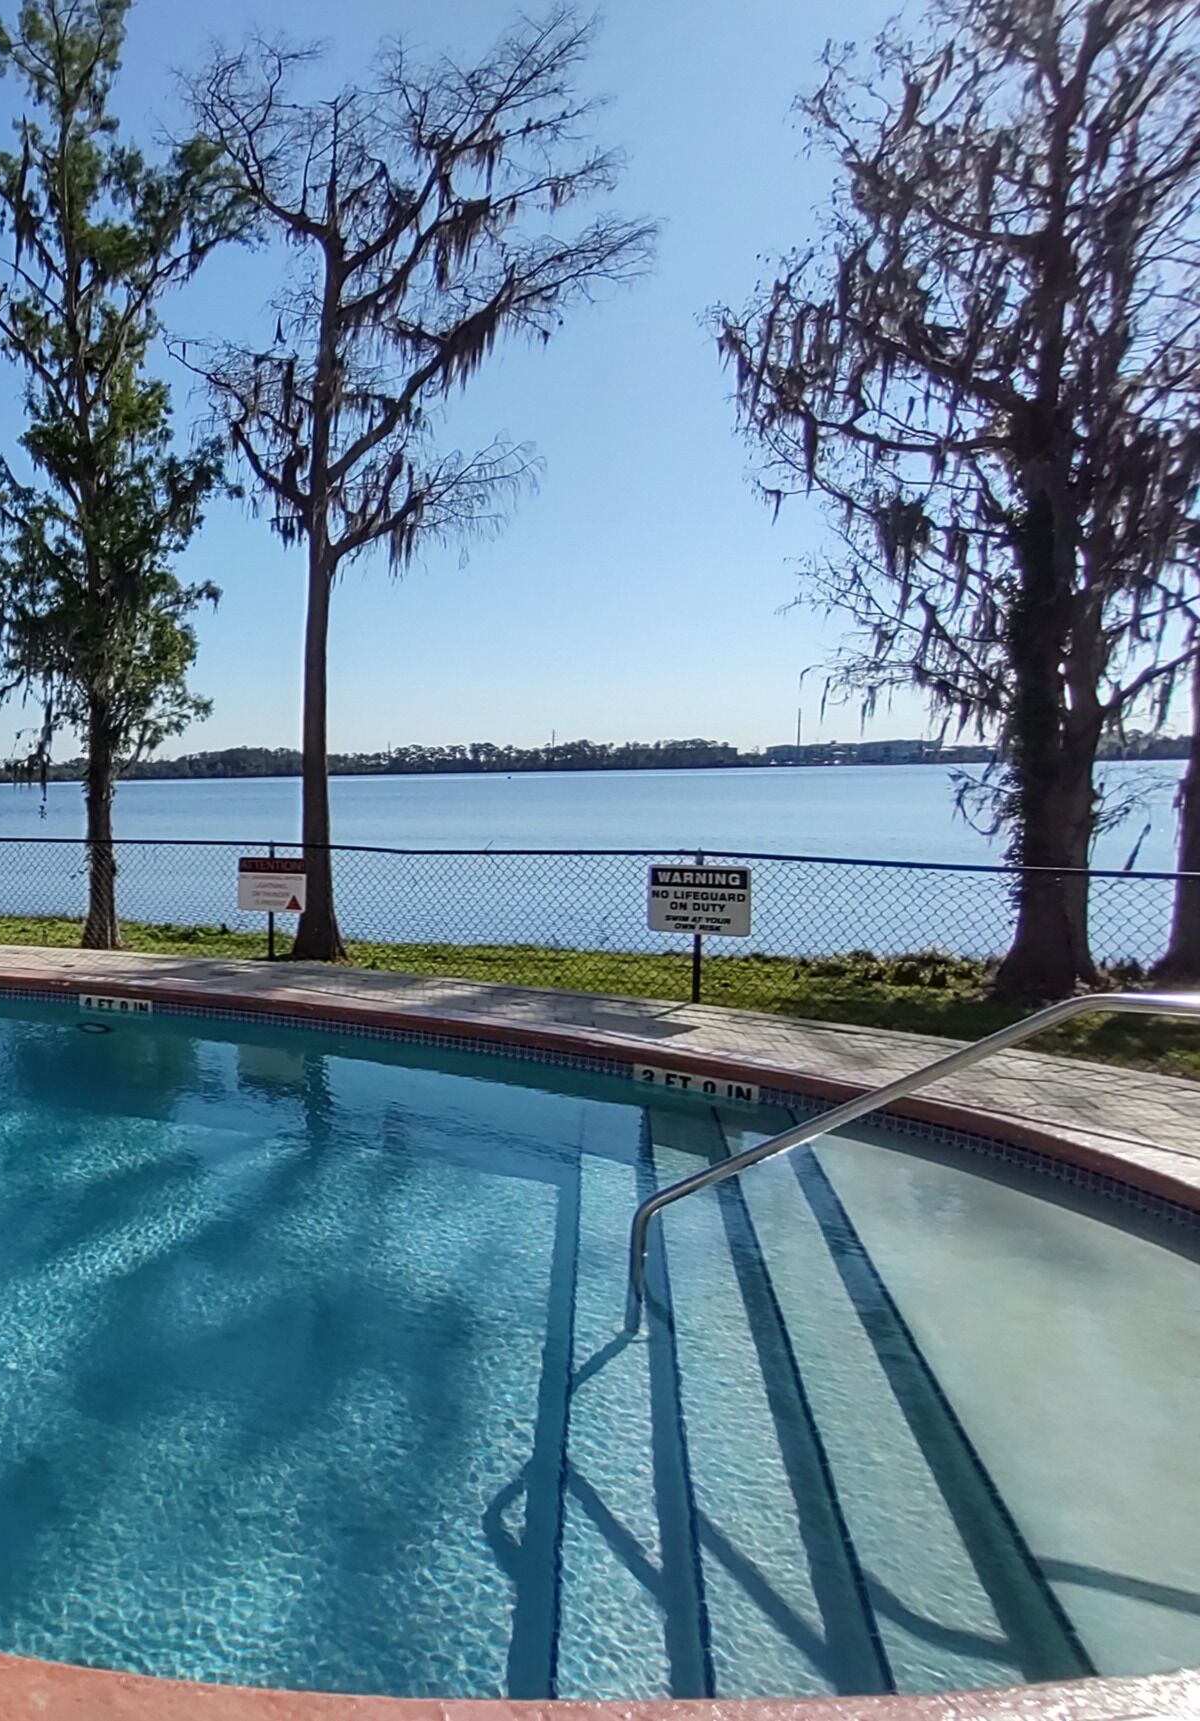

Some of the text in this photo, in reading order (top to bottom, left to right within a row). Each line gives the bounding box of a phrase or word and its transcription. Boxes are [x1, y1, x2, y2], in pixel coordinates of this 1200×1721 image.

[658, 871, 741, 886] WARNING
[652, 890, 746, 902] NO LIFEGUARD
[670, 901, 726, 912] ON DUTY
[665, 914, 689, 922] SWIM
[706, 917, 731, 925] YOUR
[675, 922, 721, 931] OWN RISK
[98, 998, 115, 1009] FT
[134, 1002, 149, 1012] IN
[665, 1073, 692, 1089] FT
[728, 1084, 752, 1101] IN
